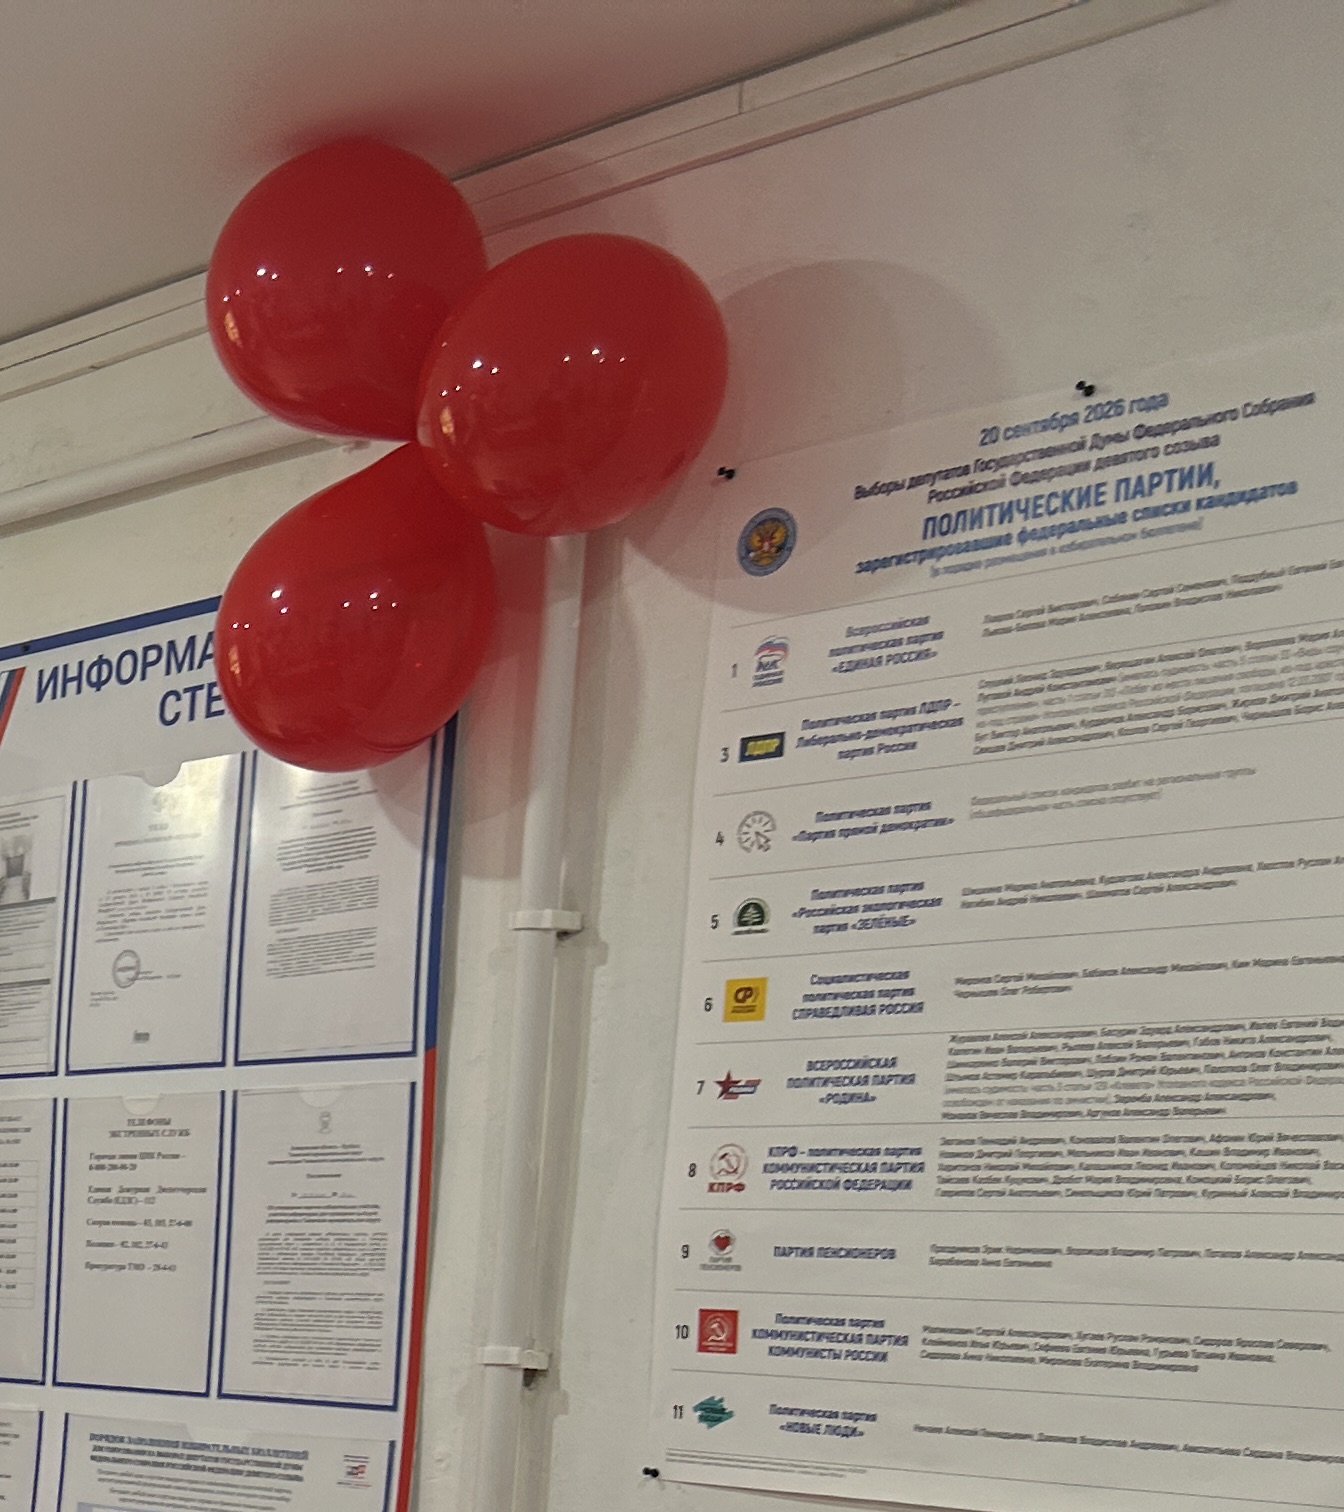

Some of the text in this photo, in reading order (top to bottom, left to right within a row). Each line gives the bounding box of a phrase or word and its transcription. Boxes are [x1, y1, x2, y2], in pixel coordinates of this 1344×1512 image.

[978, 392, 1170, 447] 20 сентября 2026 года
[853, 392, 1316, 500] Выборы депутатов Государственной Думы Федерального Собрания
[927, 434, 1221, 504] Российской Федерации девятого созыва
[921, 461, 1221, 541] ПОЛИТИЧЕСКИЕ ПАРТИИ,
[854, 480, 1299, 574] зарегистрировавшие федеральные списки кандидатов
[845, 615, 930, 638] Всероссийская
[828, 630, 944, 657] политическая партия
[36, 630, 215, 703] ИНФОРМА
[159, 681, 226, 726] СТЕ
[802, 711, 877, 731] Политическая
[880, 706, 917, 721] партия
[720, 747, 730, 763] 3
[837, 741, 918, 761] партия России
[815, 801, 932, 823] Политическая партия
[715, 831, 725, 845] 4
[811, 881, 925, 901] Политическая партия
[710, 914, 720, 929] 5
[803, 987, 915, 1003] политическая партия
[704, 997, 713, 1012] 6
[792, 1001, 925, 1021] СПРАВЕДЛИВАЯ РОССИЯ
[806, 1055, 898, 1072] ВСЕРОССИЙСКАЯ
[696, 1080, 705, 1095] 7
[786, 1073, 916, 1089] ПОЛИТИЧЕСКАЯ ПАРТИЯ
[688, 1163, 696, 1178] 8
[762, 1161, 925, 1174] КОММУНИСТИЧЕСКАЯ ПАРТИЯ
[707, 1182, 746, 1193] КПРФ
[770, 1177, 913, 1192] РОССИЙСКОЙ ФЕДЕРАЦИИ
[681, 1244, 689, 1259] 9
[774, 1245, 896, 1259] ПАРТИЯ ПЕНСИОНЕРОВ
[775, 1313, 885, 1329] Политическая партия
[675, 1324, 689, 1339] 10
[751, 1328, 909, 1346] КОММУНИСТИЧЕСКАЯ ПАРТИЯ
[768, 1346, 888, 1362] КОММУНИСТЫ РОССИИ
[673, 1404, 683, 1420] 11
[769, 1403, 878, 1422] Политическая партия
